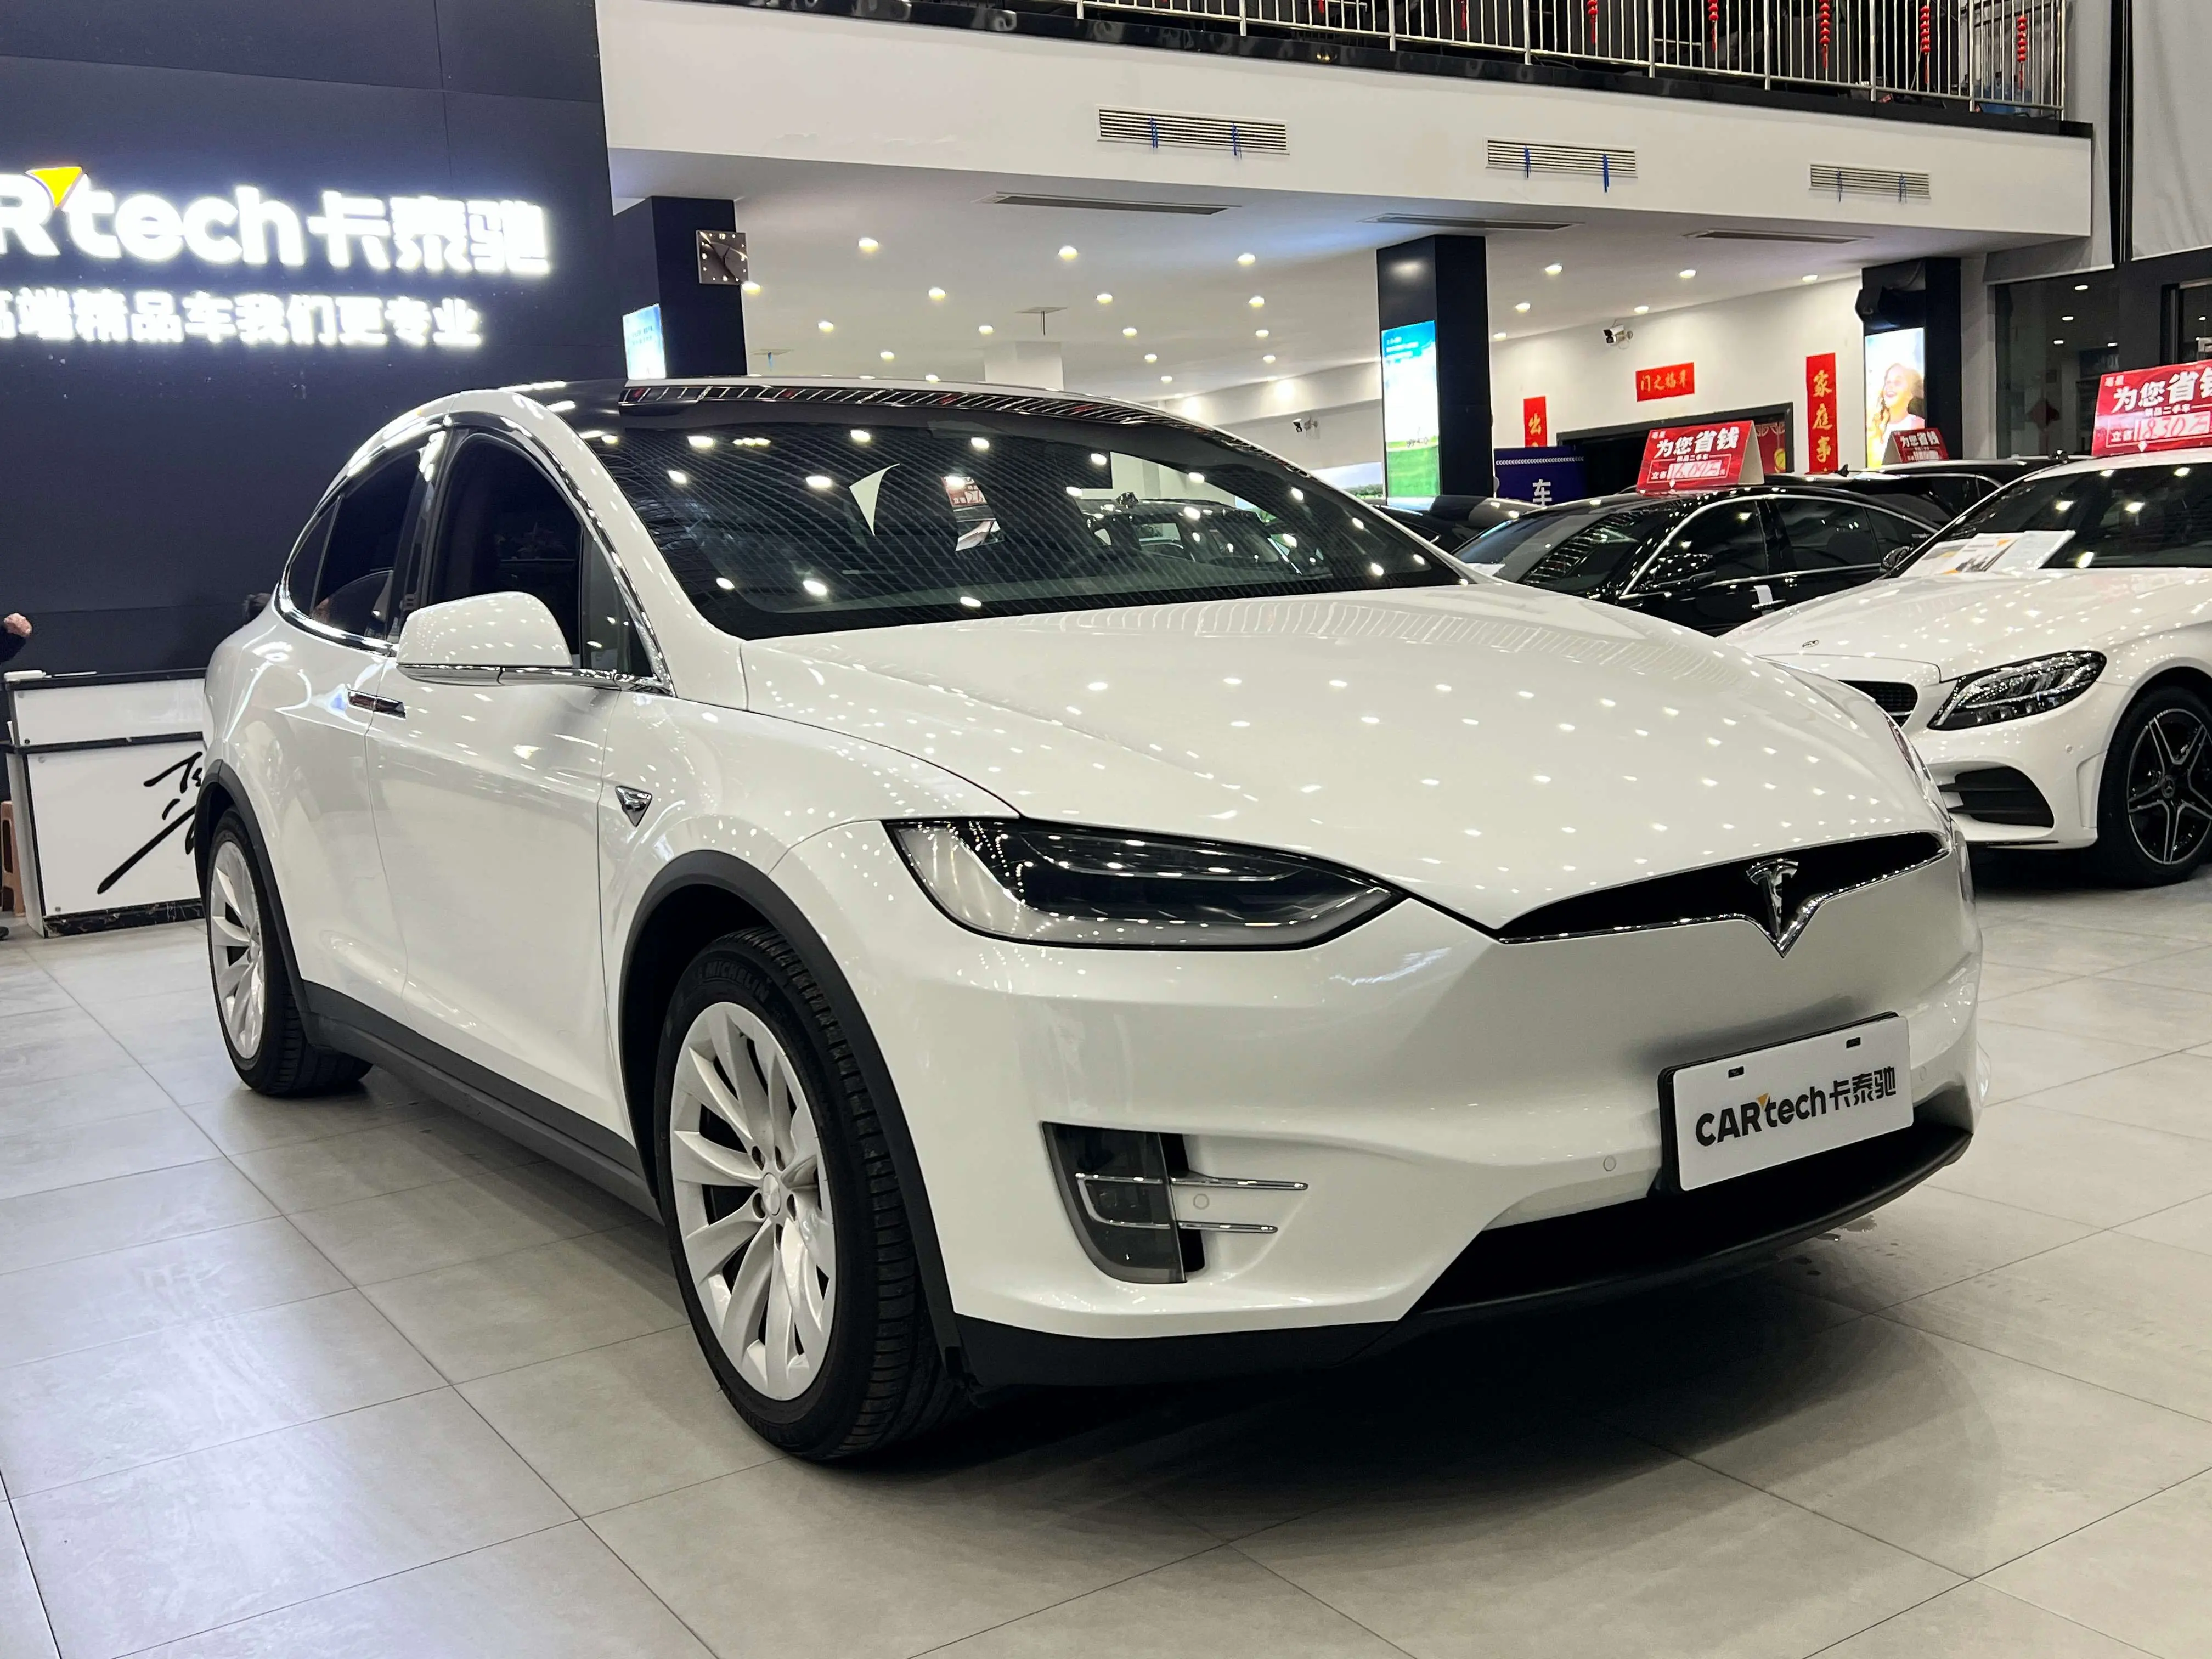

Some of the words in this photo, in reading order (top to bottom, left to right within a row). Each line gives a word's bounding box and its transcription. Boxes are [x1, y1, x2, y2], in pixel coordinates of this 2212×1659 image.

[0, 287, 482, 345] 端精品车我们更专业
[1654, 426, 1740, 459] 为您省钱
